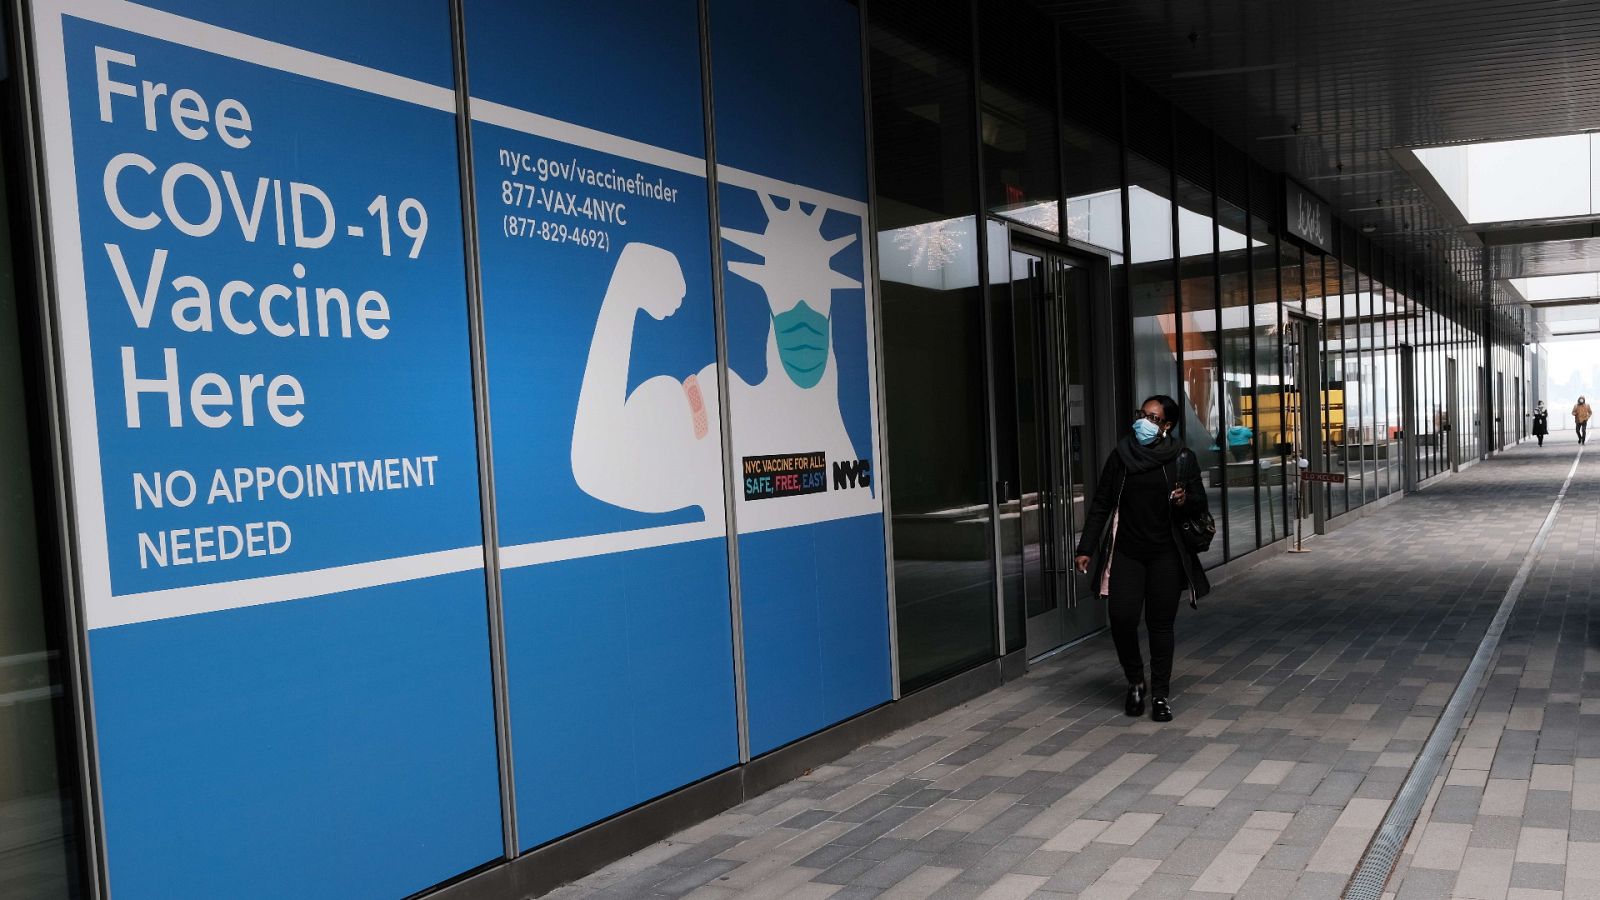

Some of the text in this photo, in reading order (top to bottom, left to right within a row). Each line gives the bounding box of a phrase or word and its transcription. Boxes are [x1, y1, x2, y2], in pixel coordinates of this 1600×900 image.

[95, 46, 252, 148] Free
[500, 149, 678, 203] nyc.gov/vaccinefinder
[502, 181, 628, 225] 877-VAX-4NYC
[503, 215, 610, 252] (877-829-4692)
[104, 243, 391, 340] Vaccine
[121, 346, 305, 428] Here
[133, 456, 438, 509] NO APPOINTMENT
[745, 460, 761, 473] NYC
[762, 458, 793, 472] VACCINE
[794, 457, 808, 470] FOR
[746, 472, 824, 494] SAFE, FREE, EASY
[833, 460, 870, 490] NYC
[138, 521, 292, 568] NEEDED
